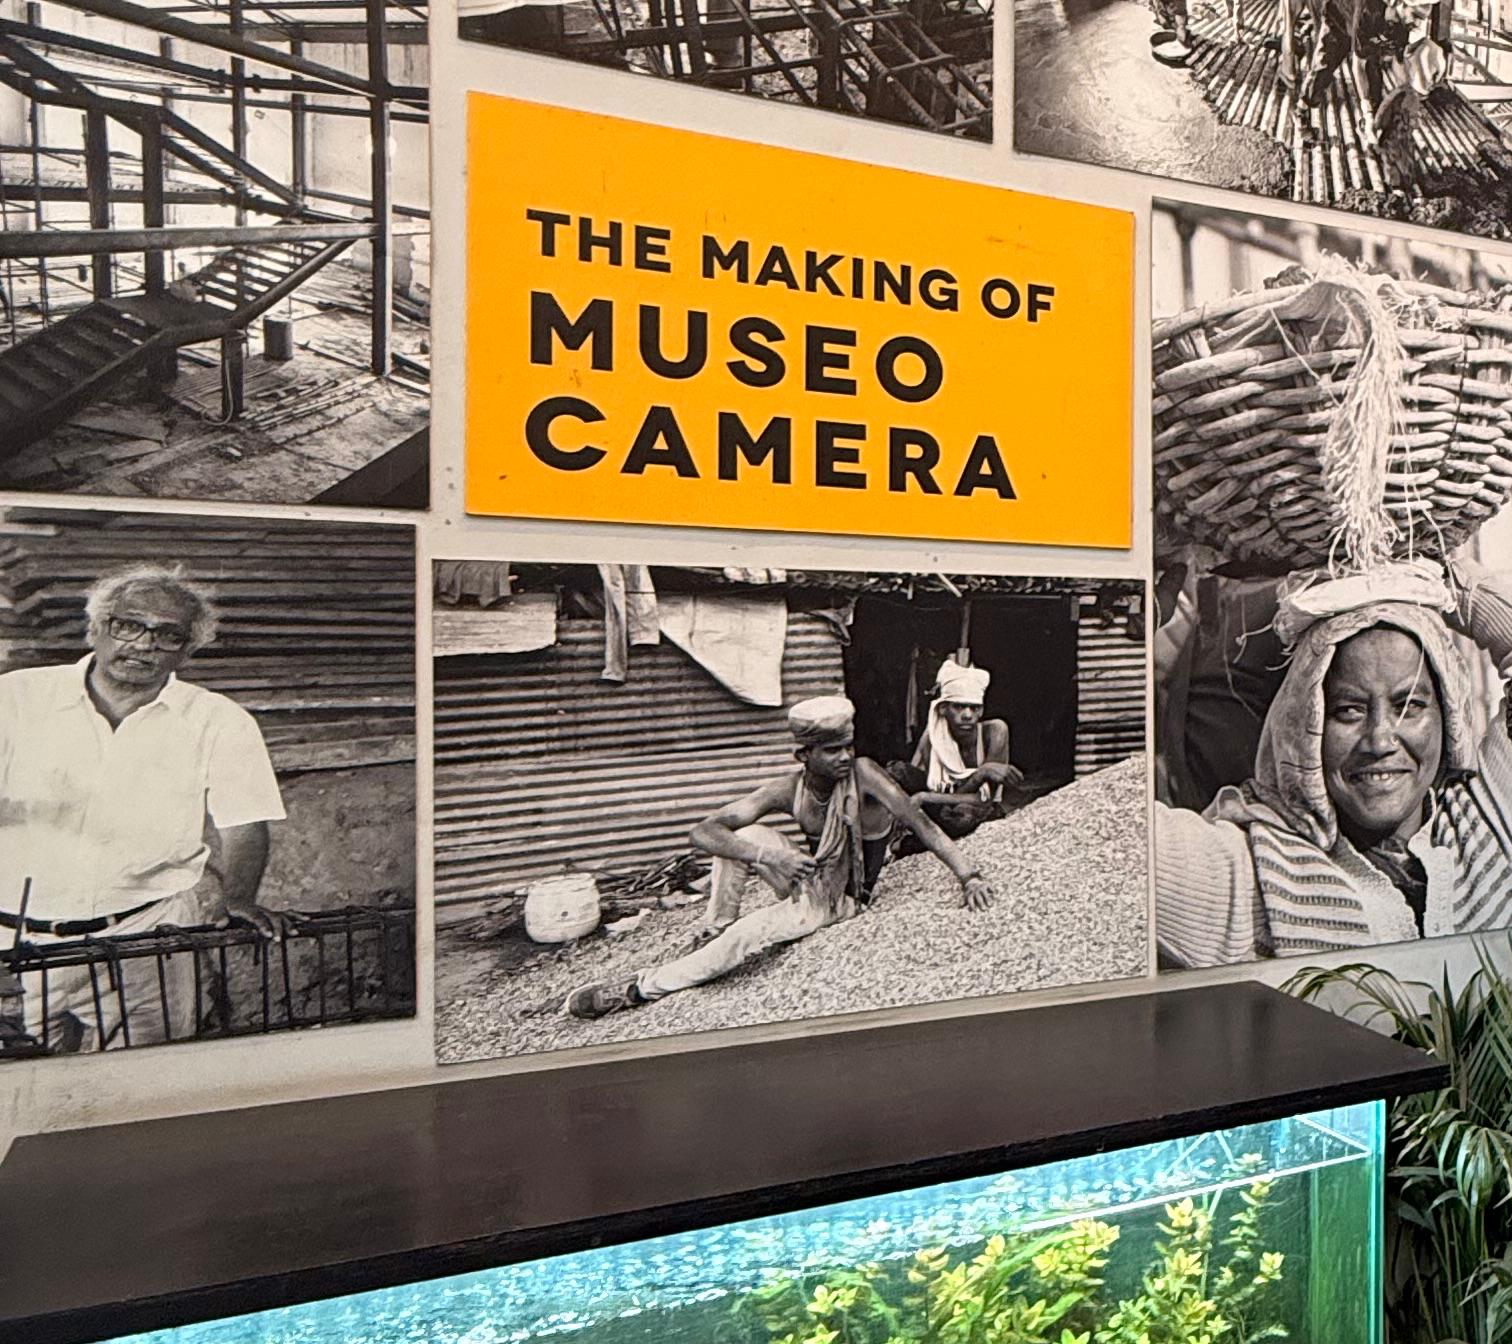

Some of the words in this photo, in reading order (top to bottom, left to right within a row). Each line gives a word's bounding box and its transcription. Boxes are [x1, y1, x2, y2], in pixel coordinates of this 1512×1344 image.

[526, 209, 671, 273] THE
[702, 234, 959, 312] MAKING
[981, 278, 1056, 323] OF
[530, 290, 944, 403] MUSEO
[525, 396, 1018, 501] CAMERA
